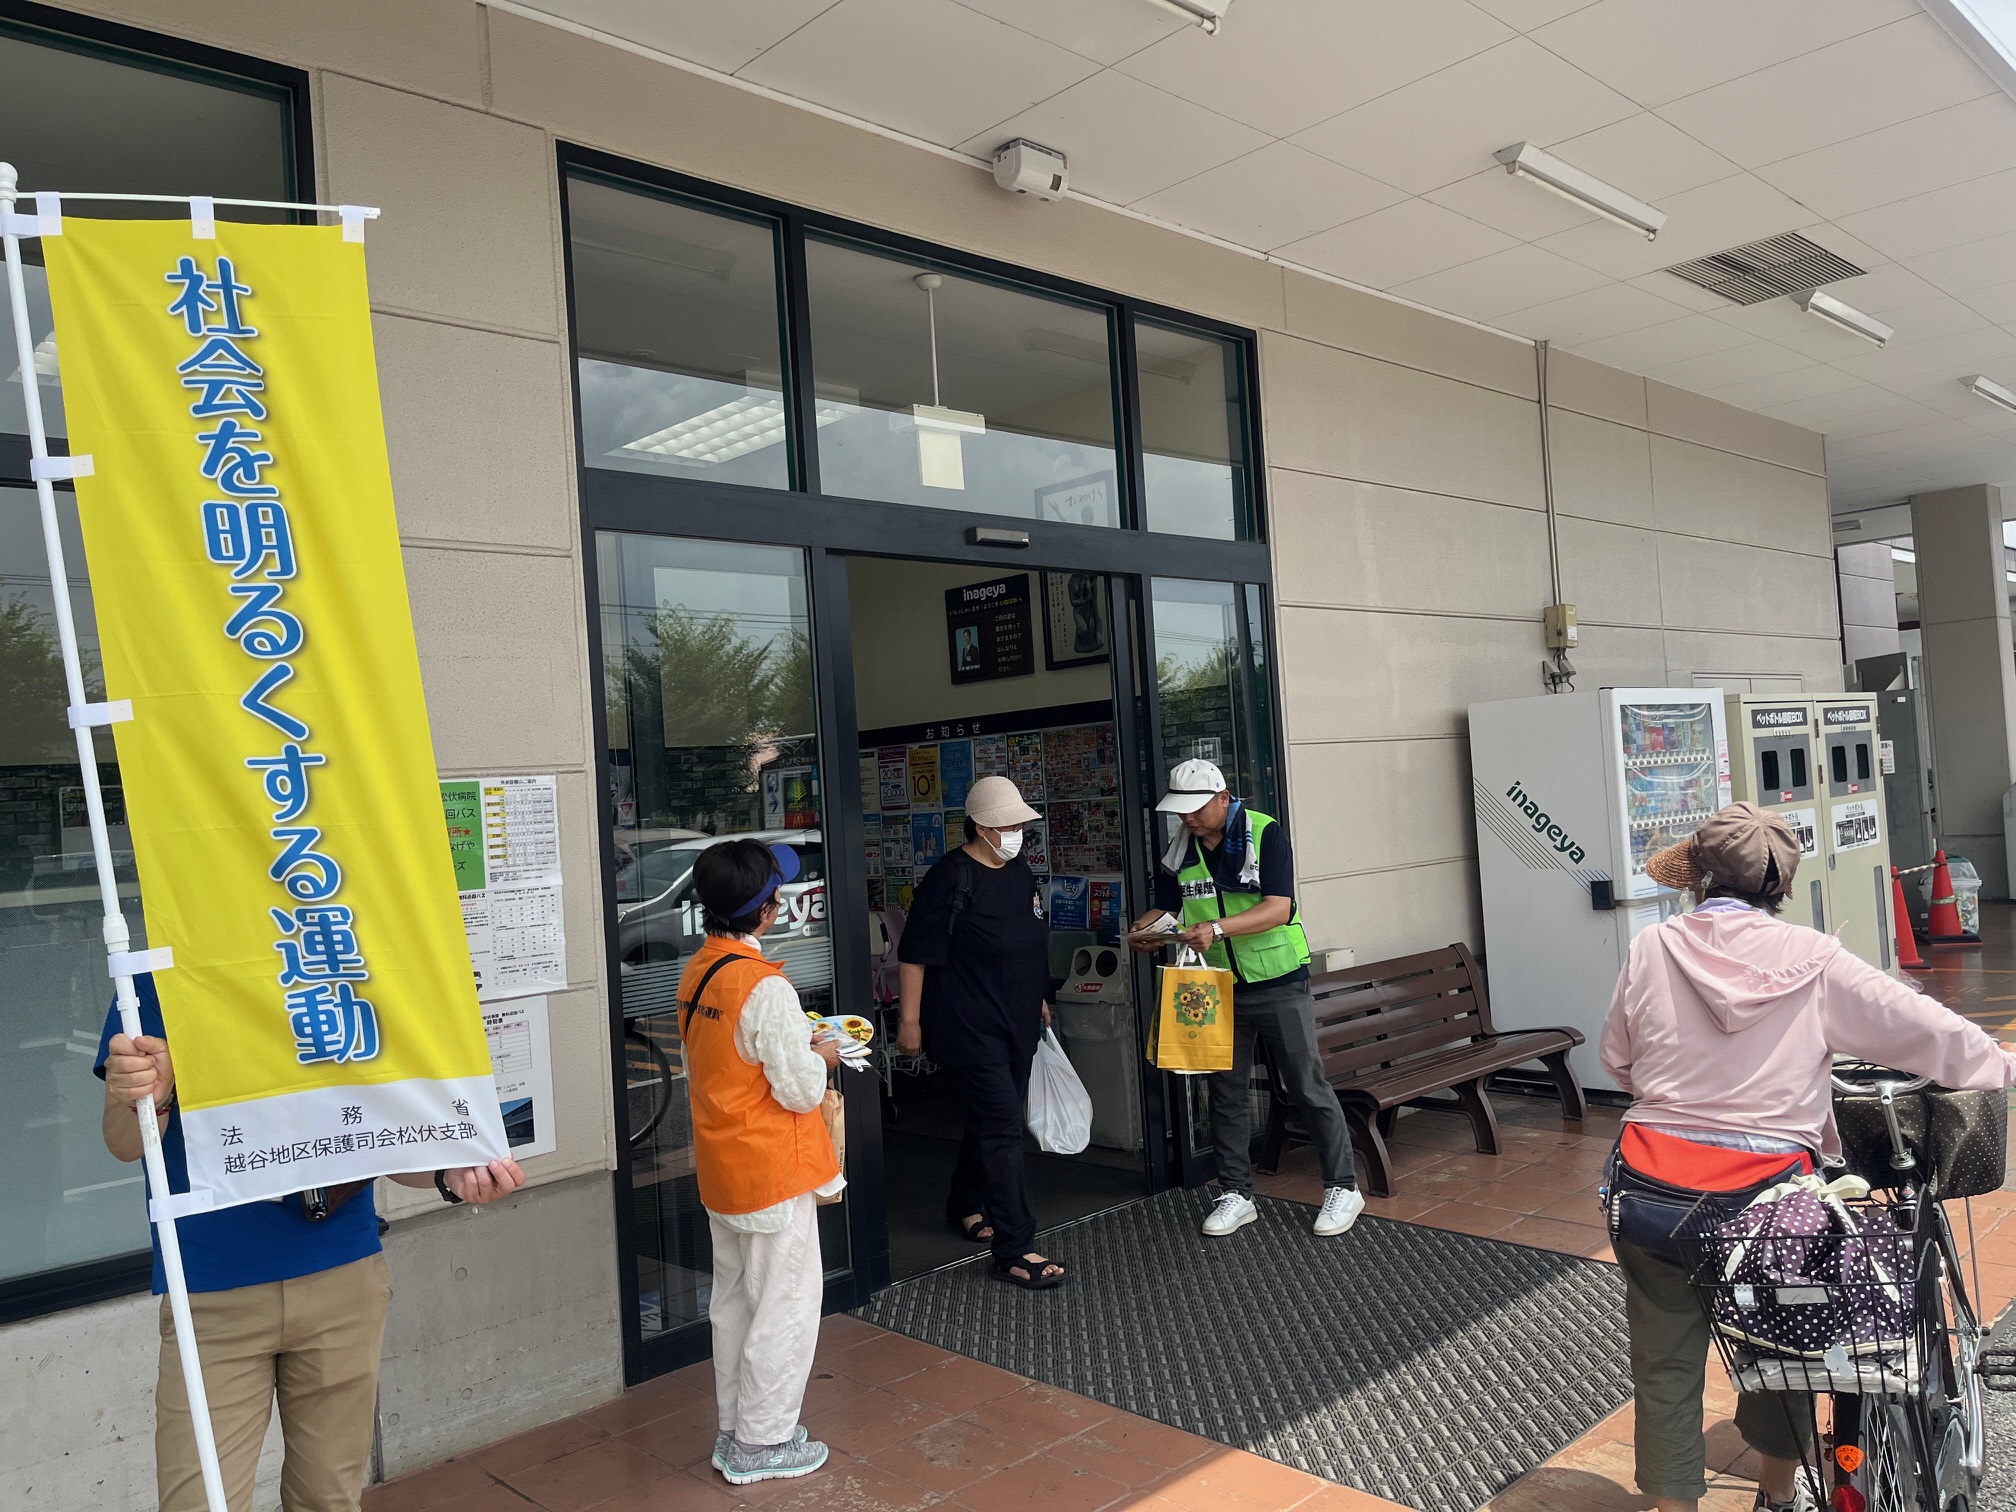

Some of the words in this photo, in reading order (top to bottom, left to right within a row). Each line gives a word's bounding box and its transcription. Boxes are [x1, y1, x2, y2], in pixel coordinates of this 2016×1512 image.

[963, 583, 1006, 601] inageya
[164, 256, 381, 1065] 社会を明るくする運動
[926, 722, 982, 739] お知らせ
[1506, 780, 1586, 865] inageya
[224, 1121, 478, 1175] 越谷地区保護司会松伏支部
